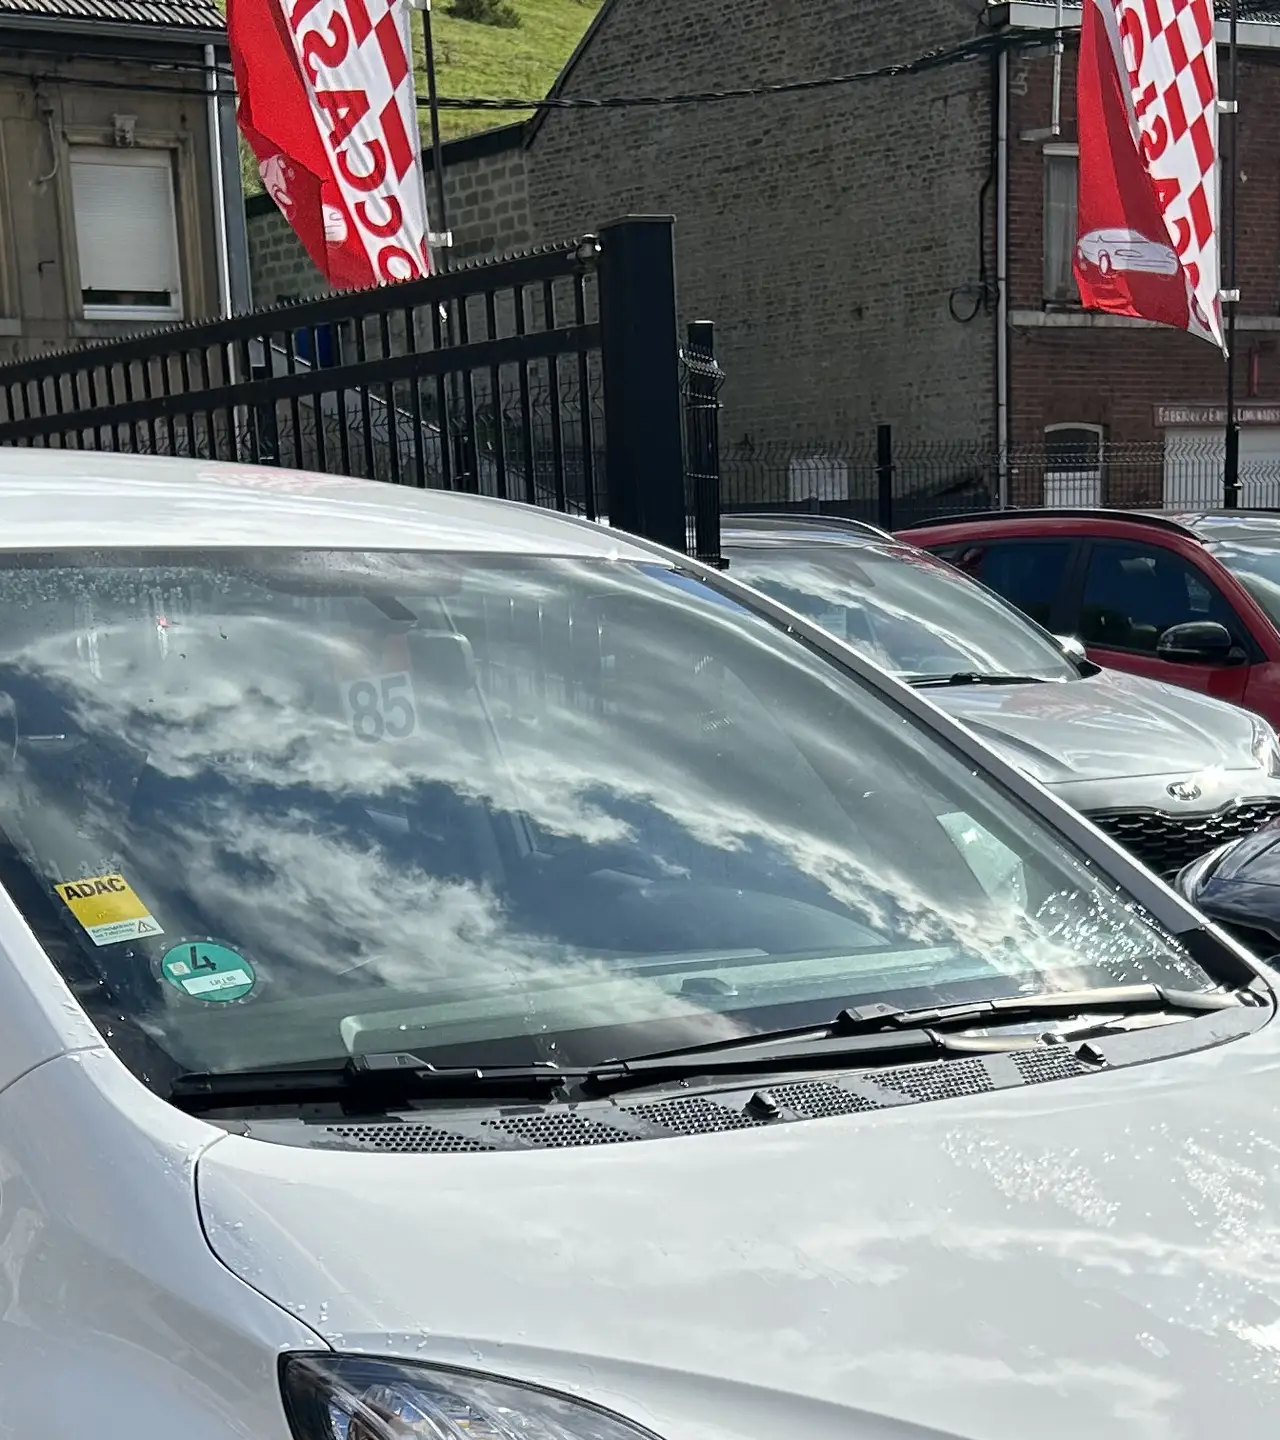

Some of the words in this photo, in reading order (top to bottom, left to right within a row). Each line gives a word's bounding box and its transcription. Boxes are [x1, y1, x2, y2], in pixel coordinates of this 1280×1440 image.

[348, 675, 416, 744] 85
[63, 877, 126, 901] ADAC
[190, 945, 217, 971] 4
